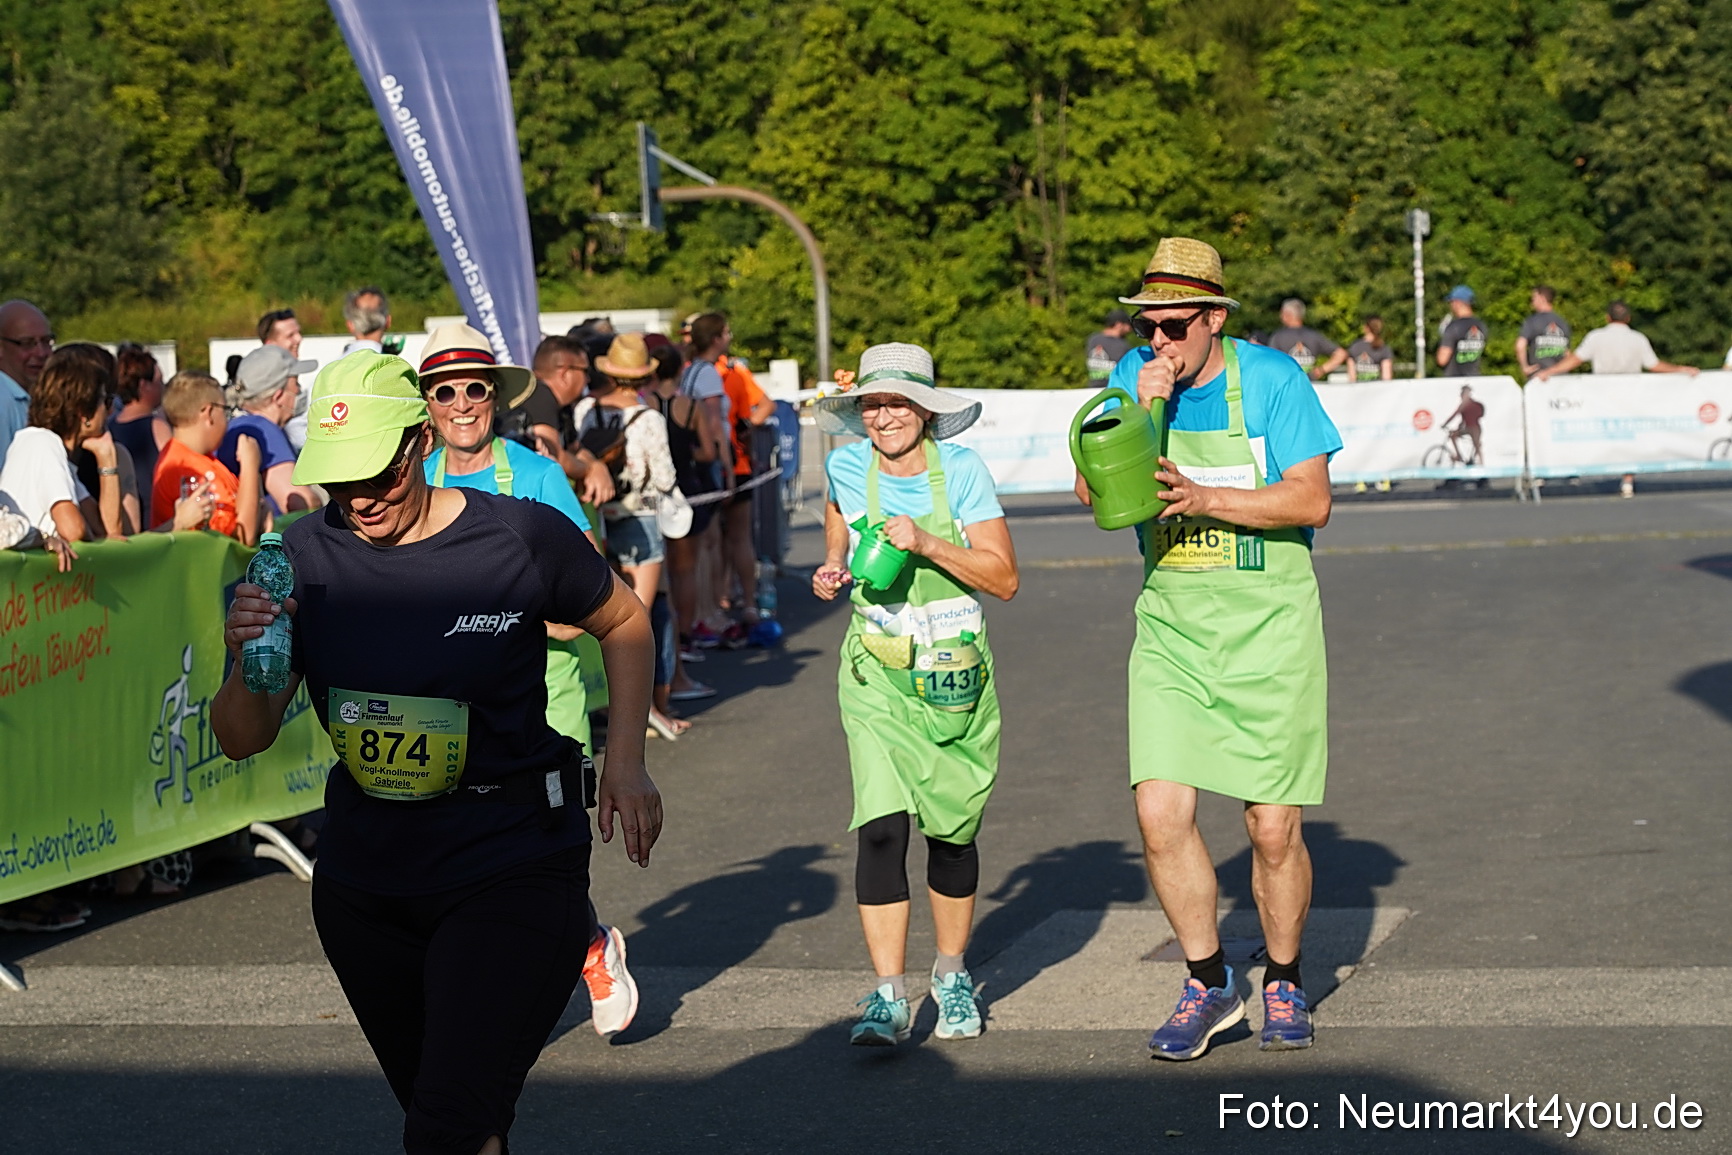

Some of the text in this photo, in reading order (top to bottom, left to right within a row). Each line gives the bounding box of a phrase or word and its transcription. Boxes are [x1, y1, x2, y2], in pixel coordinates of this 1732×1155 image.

[1163, 526, 1220, 548] 1446
[1222, 529, 1231, 561] 2022
[1188, 549, 1223, 558] Christian
[32, 573, 95, 622] Firmen
[443, 614, 500, 638] JURA
[46, 604, 112, 683] länger!
[926, 663, 980, 691] 1437
[928, 693, 949, 701] Lang
[361, 712, 404, 722] Firmenlauf
[336, 729, 348, 764] ALK
[359, 728, 431, 767] 874
[358, 763, 430, 779] Vogl-Knollmeyer
[444, 740, 460, 784] 2022
[374, 776, 411, 787] Gabriele
